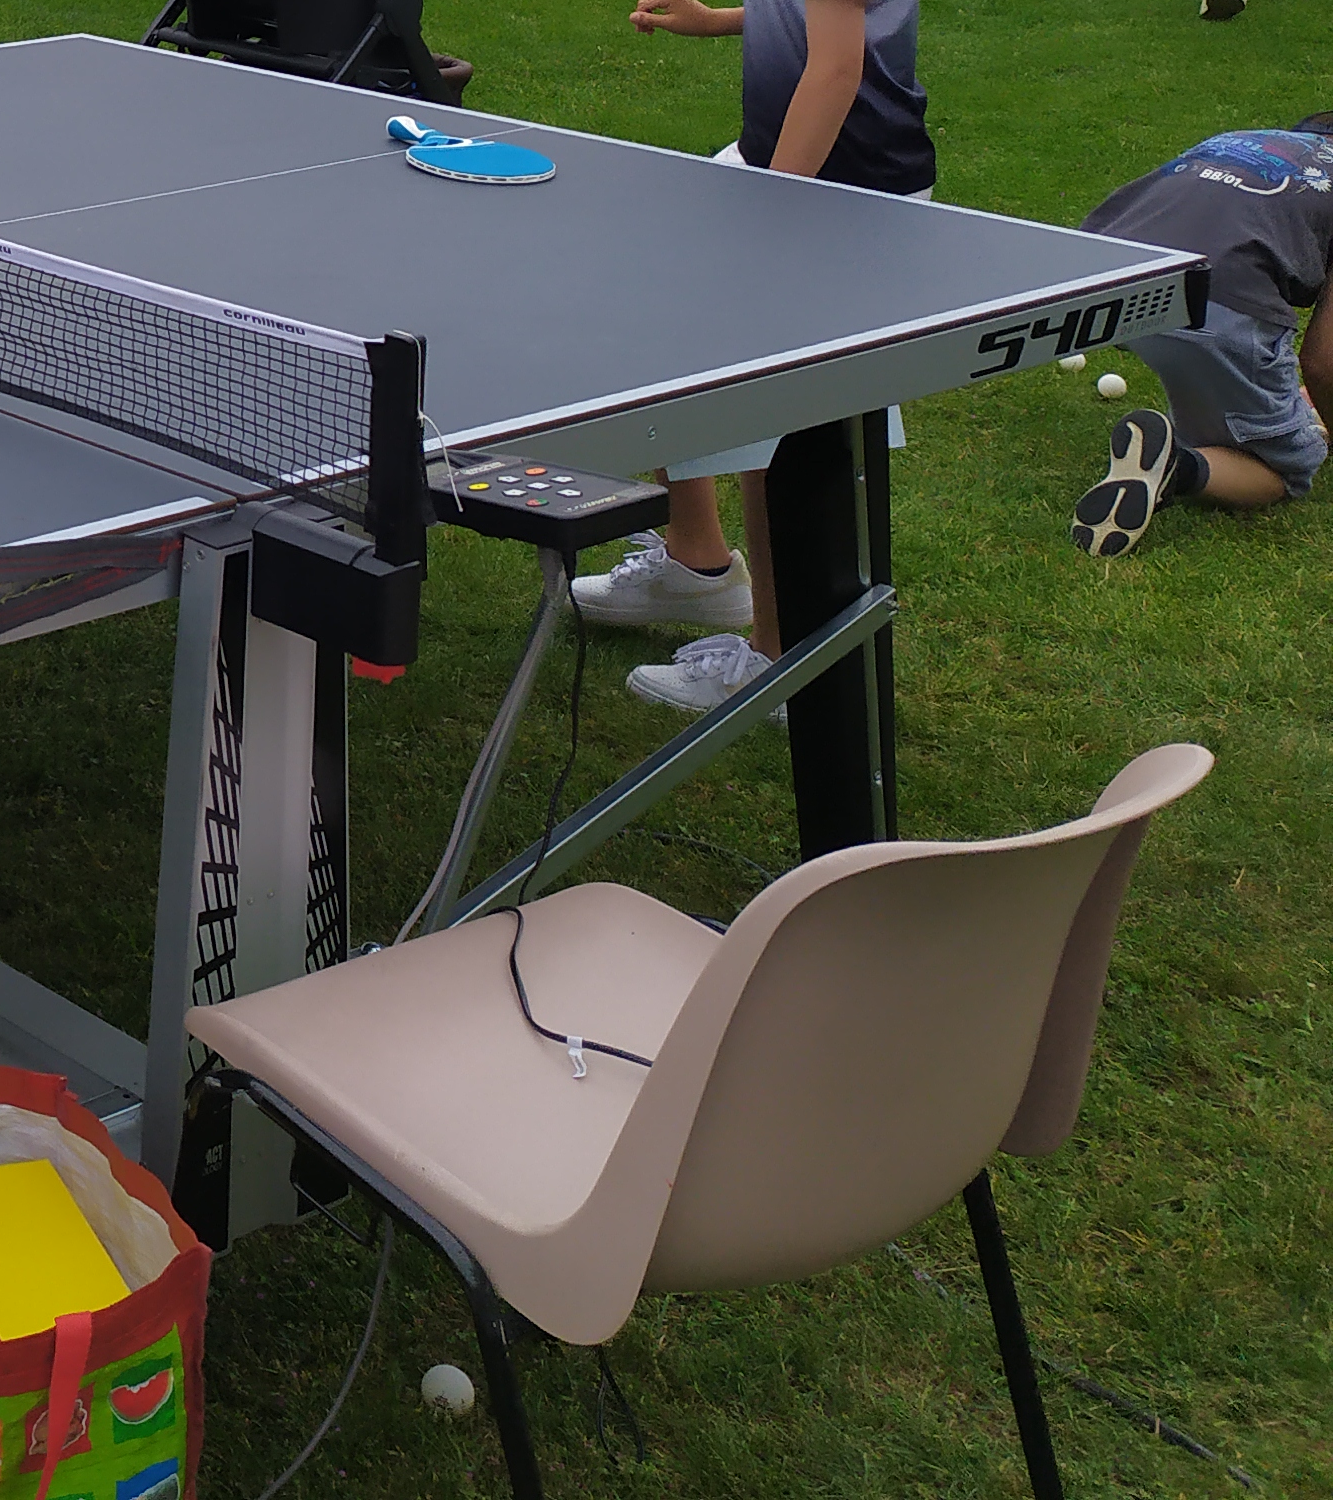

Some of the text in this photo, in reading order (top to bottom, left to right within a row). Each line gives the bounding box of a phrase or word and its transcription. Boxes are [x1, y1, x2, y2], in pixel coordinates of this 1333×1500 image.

[1199, 168, 1243, 188] BB/01
[223, 308, 307, 336] cornilleau
[969, 298, 1124, 379] 540
